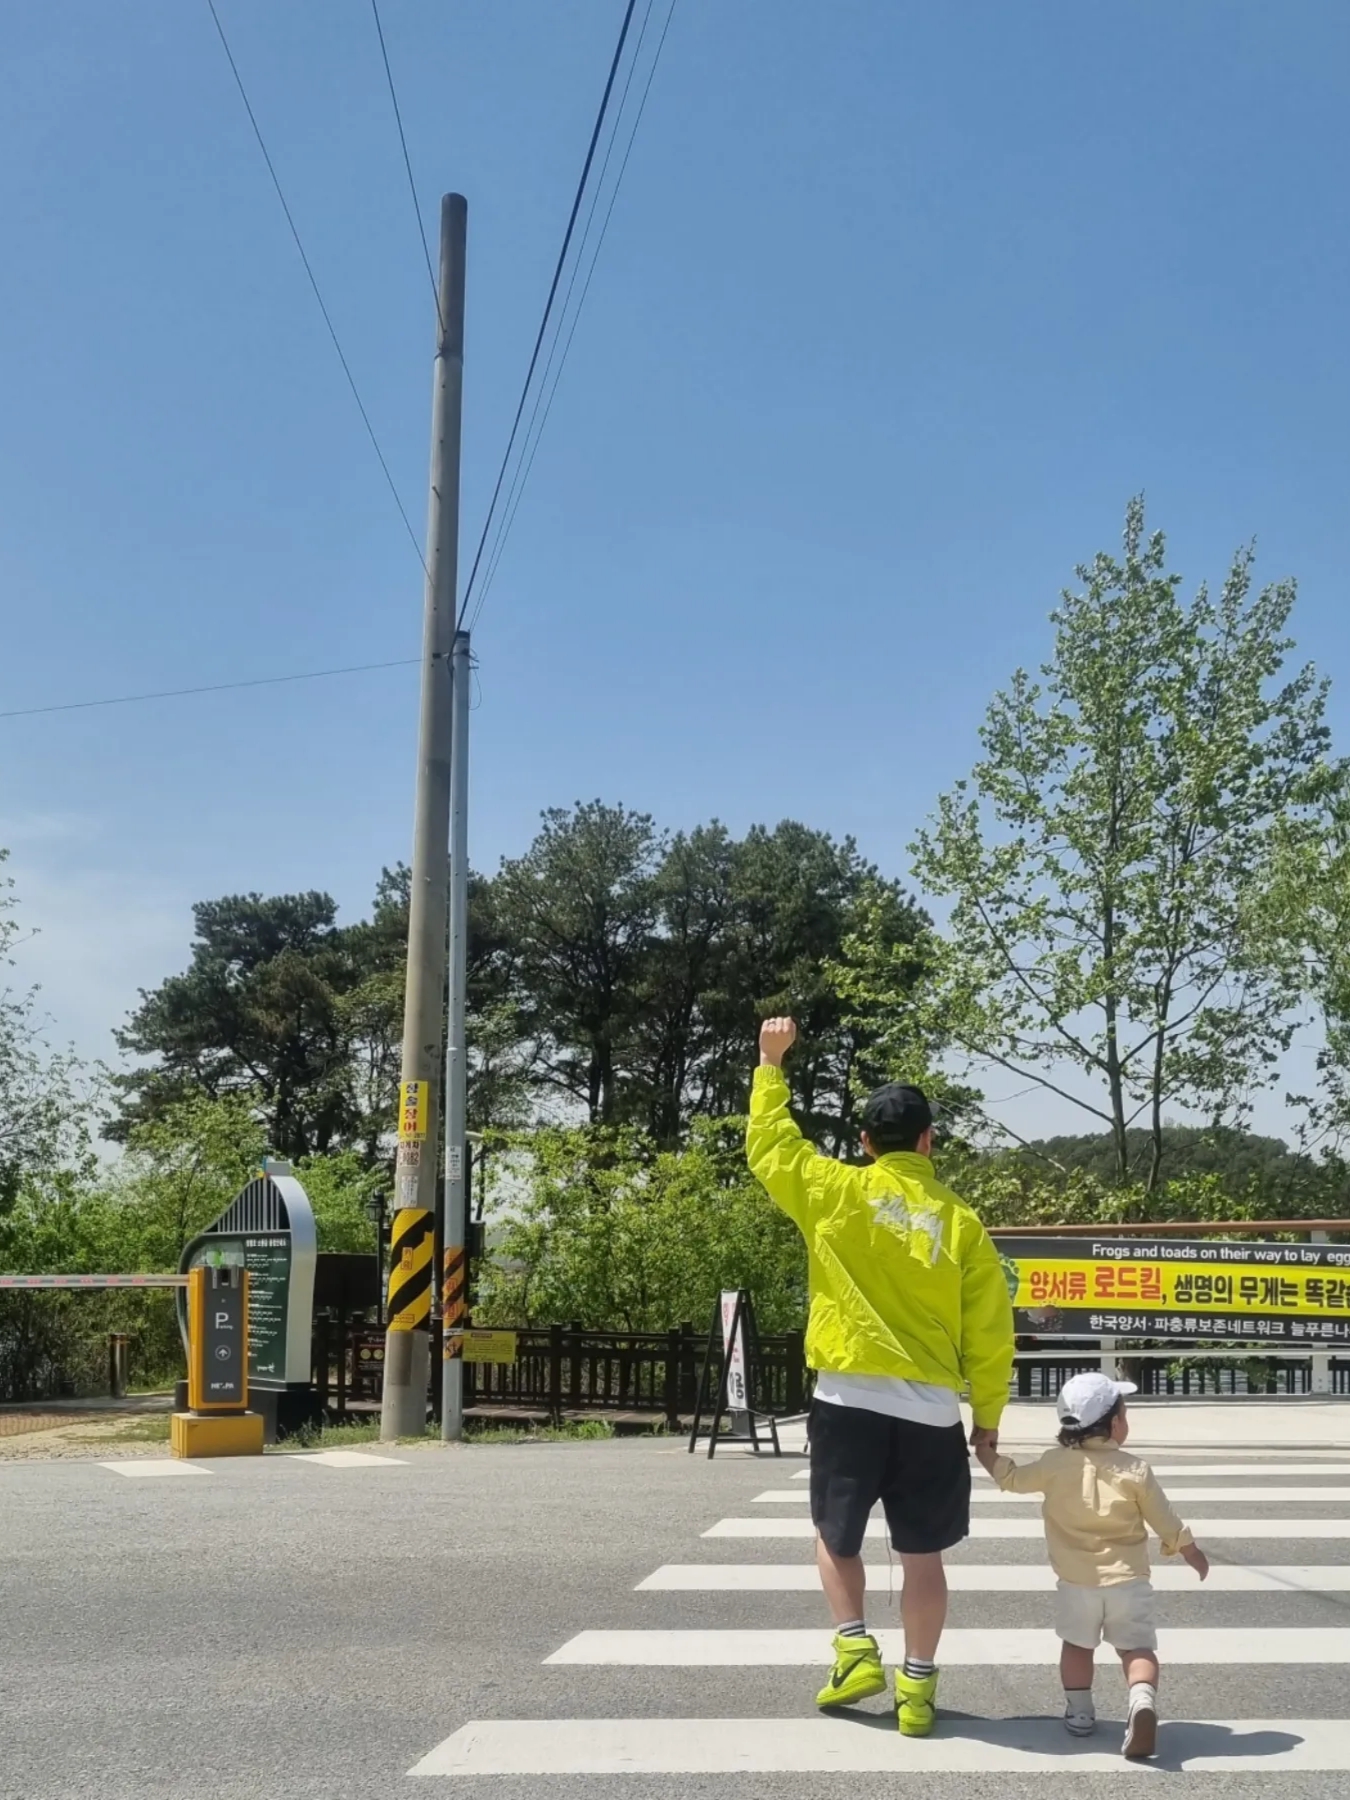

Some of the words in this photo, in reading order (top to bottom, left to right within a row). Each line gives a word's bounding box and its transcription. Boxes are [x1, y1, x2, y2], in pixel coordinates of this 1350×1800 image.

[1092, 1244, 1130, 1259] Frogs
[1133, 1246, 1158, 1258] and
[1160, 1246, 1197, 1259] toads
[1200, 1249, 1217, 1259] on
[1220, 1247, 1251, 1260] their
[1254, 1250, 1281, 1264] way
[1284, 1250, 1298, 1261] to
[1301, 1249, 1321, 1265] lay
[1030, 1271, 1087, 1300] 양서류
[1094, 1266, 1167, 1305] 로드킬,
[1174, 1274, 1233, 1304] 생명의
[1239, 1276, 1298, 1307] 무게는
[1305, 1278, 1350, 1308] 똑같
